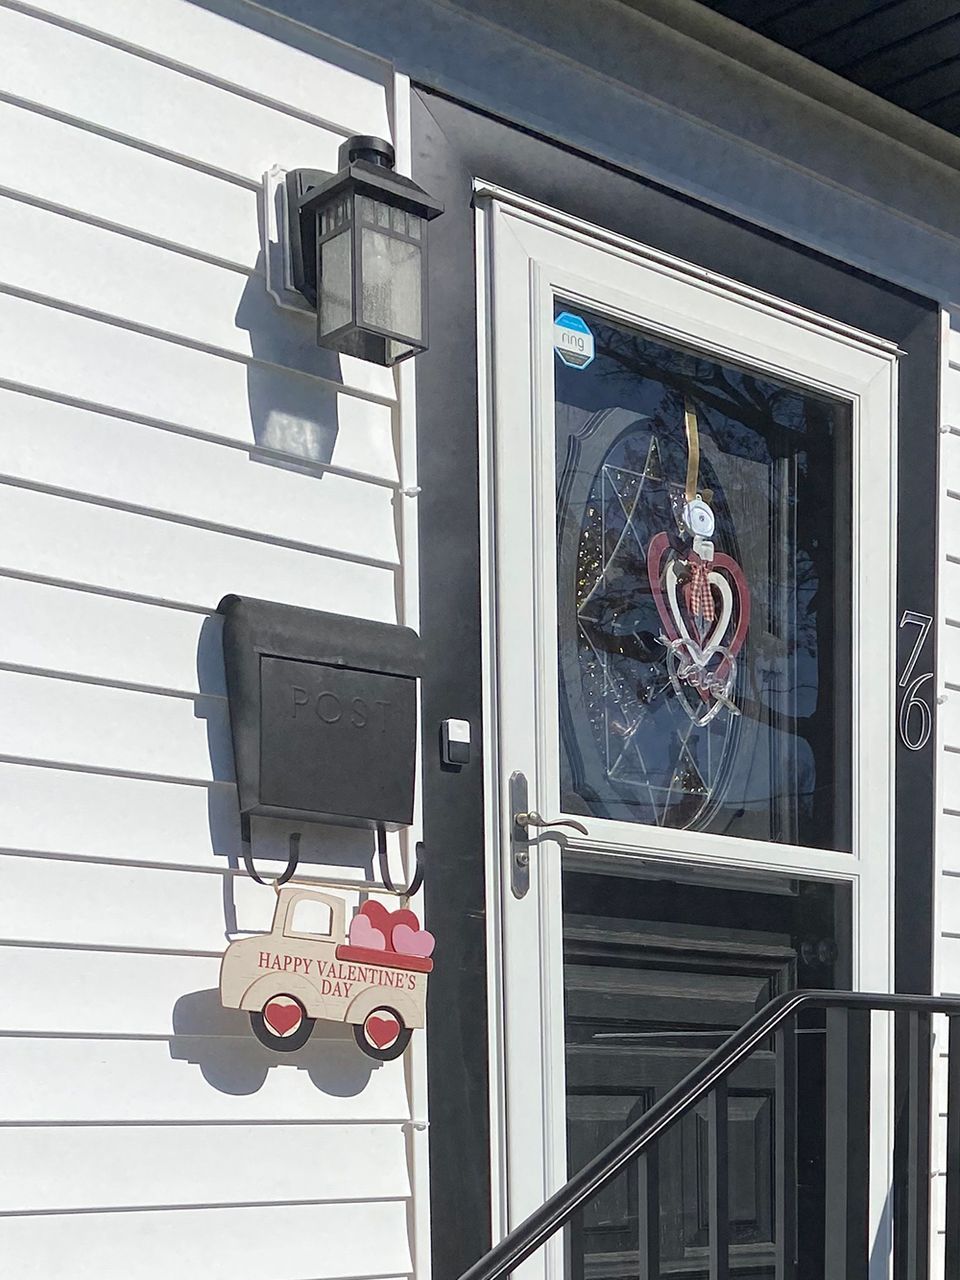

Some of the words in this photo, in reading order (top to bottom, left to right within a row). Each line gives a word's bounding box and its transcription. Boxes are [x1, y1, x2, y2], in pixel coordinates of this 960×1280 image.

[562, 331, 584, 351] ring
[899, 610, 933, 751] 76
[290, 684, 392, 733] POST
[258, 951, 313, 975] HAPPY
[316, 960, 417, 990] VALENTINE'S
[321, 979, 353, 998] DAY
